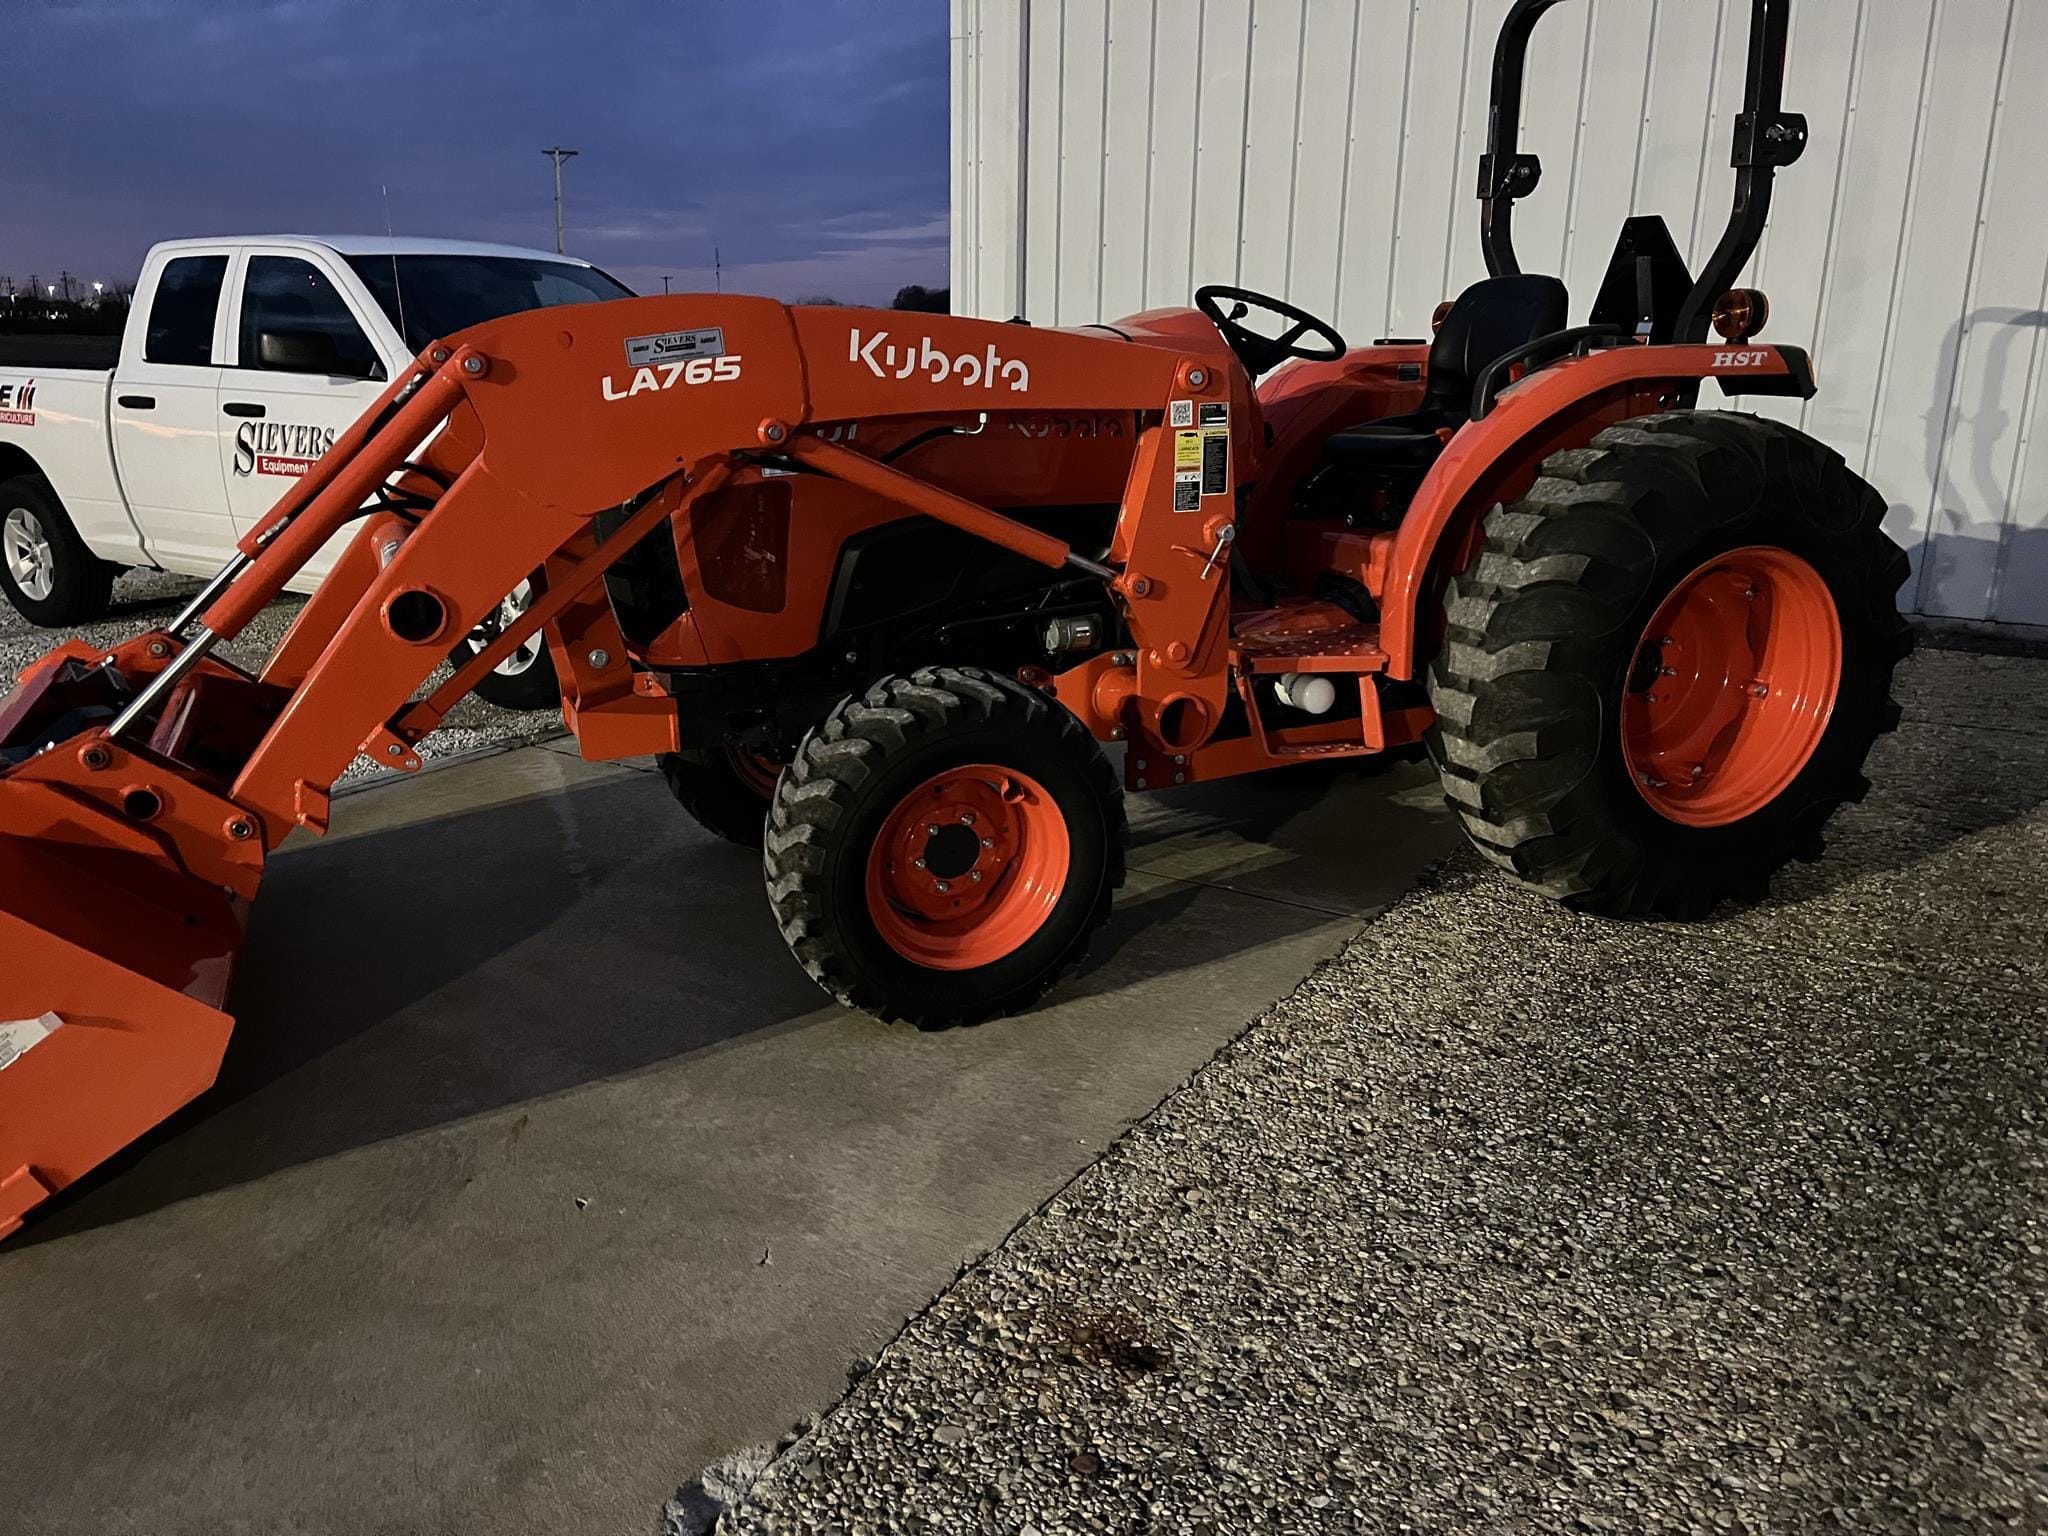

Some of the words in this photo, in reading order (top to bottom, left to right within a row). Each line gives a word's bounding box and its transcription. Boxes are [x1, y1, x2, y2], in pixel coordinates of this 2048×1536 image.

[602, 355, 742, 401] LA765
[849, 328, 1029, 392] Kubota
[1711, 351, 1768, 367] HST
[233, 421, 335, 478] SIEVERS
[262, 458, 309, 475] Equipment
